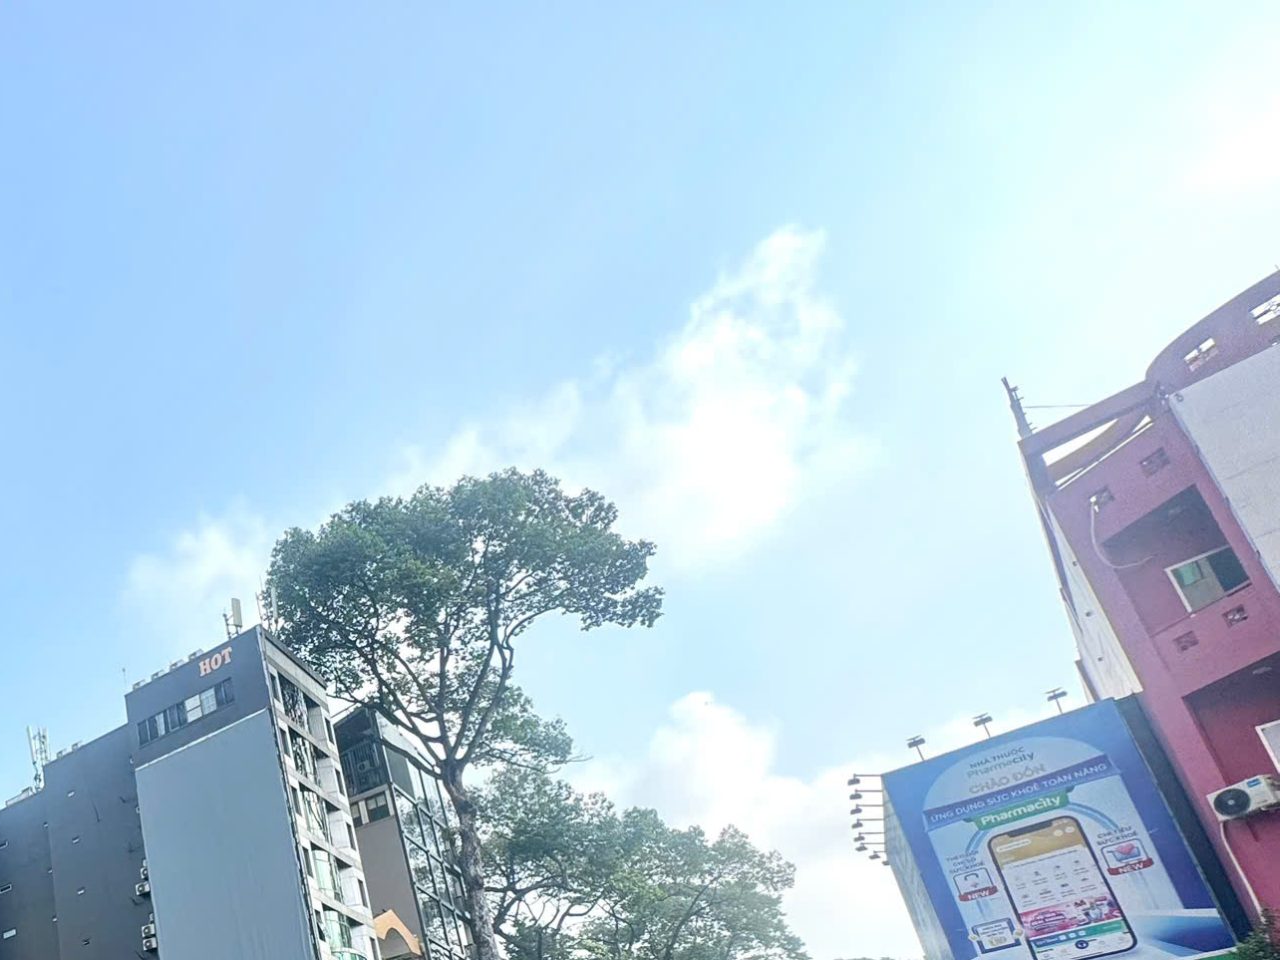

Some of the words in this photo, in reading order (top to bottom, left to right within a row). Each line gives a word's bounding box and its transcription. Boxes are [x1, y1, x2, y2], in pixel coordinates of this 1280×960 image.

[199, 646, 232, 677] HOT
[967, 752, 1034, 777] Pharmacity
[980, 796, 1062, 826] Pharmacity
[1119, 861, 1144, 873] NEW
